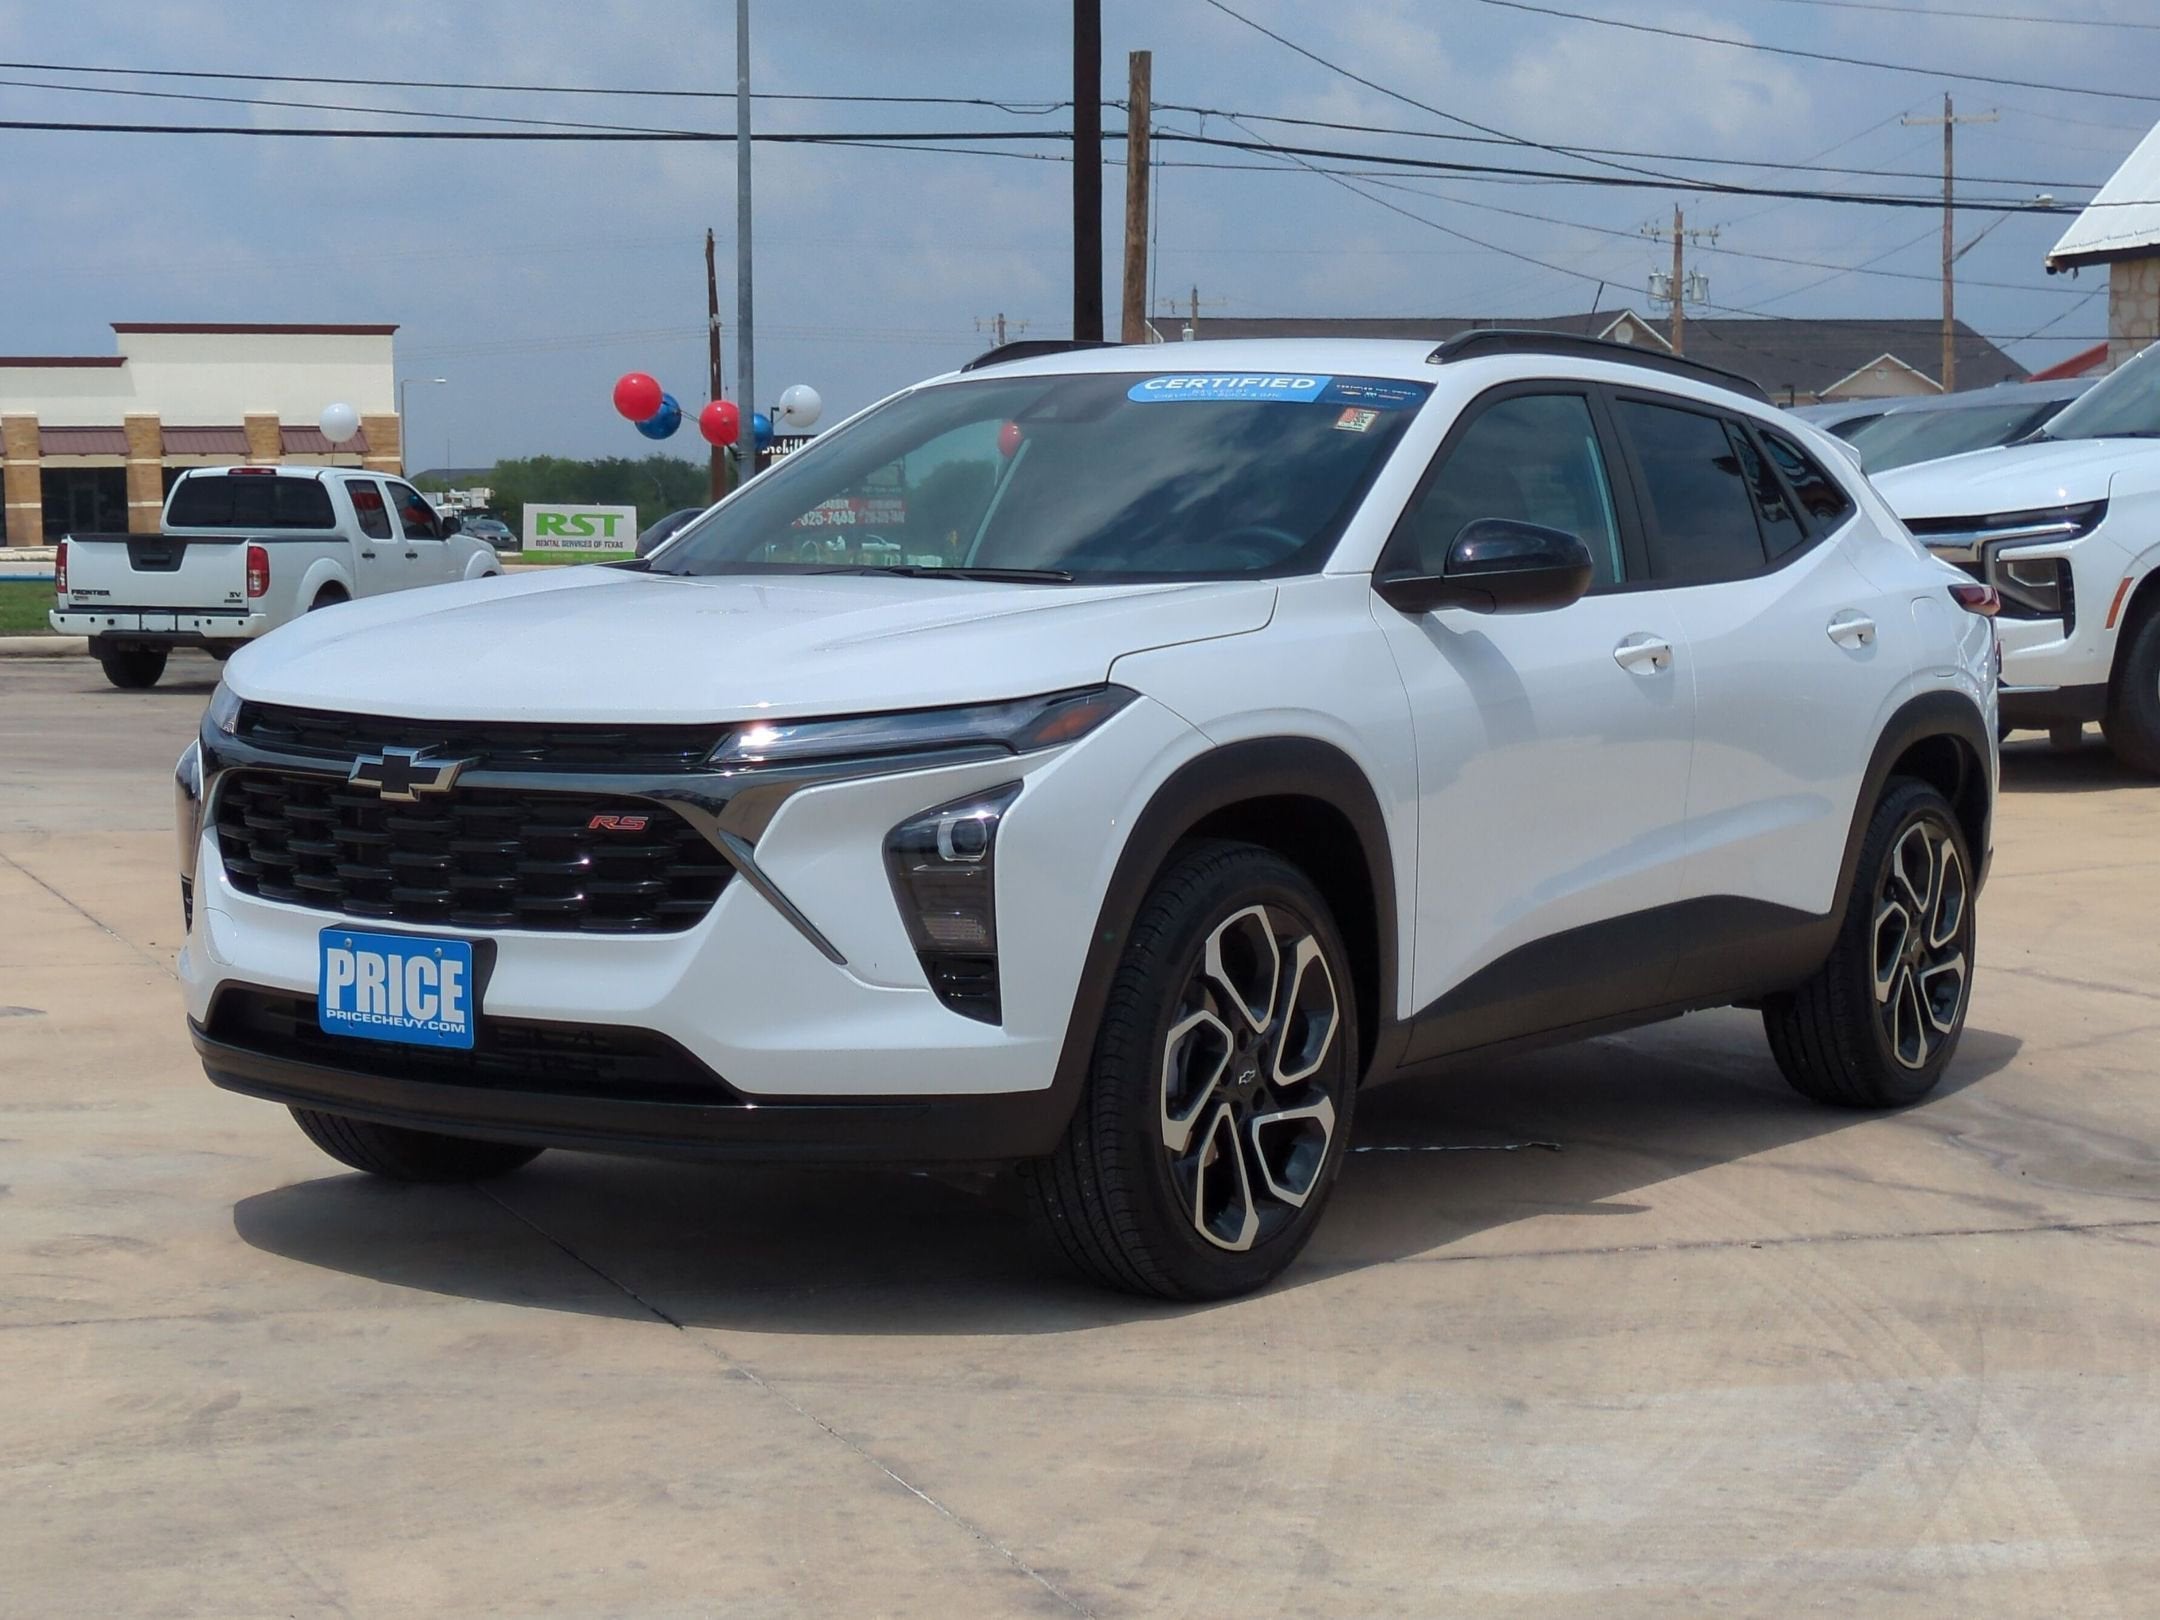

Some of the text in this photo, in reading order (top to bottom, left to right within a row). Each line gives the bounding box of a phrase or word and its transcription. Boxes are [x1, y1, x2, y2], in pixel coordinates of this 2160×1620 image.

[1144, 377, 1316, 389] CERTIFIED
[536, 512, 624, 537] RST
[535, 540, 560, 548] RENTAL
[562, 540, 592, 548] SERVICES
[604, 541, 624, 549] TEXAS
[71, 588, 111, 597] FRONTIER
[588, 815, 649, 830] RS
[326, 948, 465, 1024] PRICE
[326, 1009, 466, 1034] PRICECHEVY.COM
